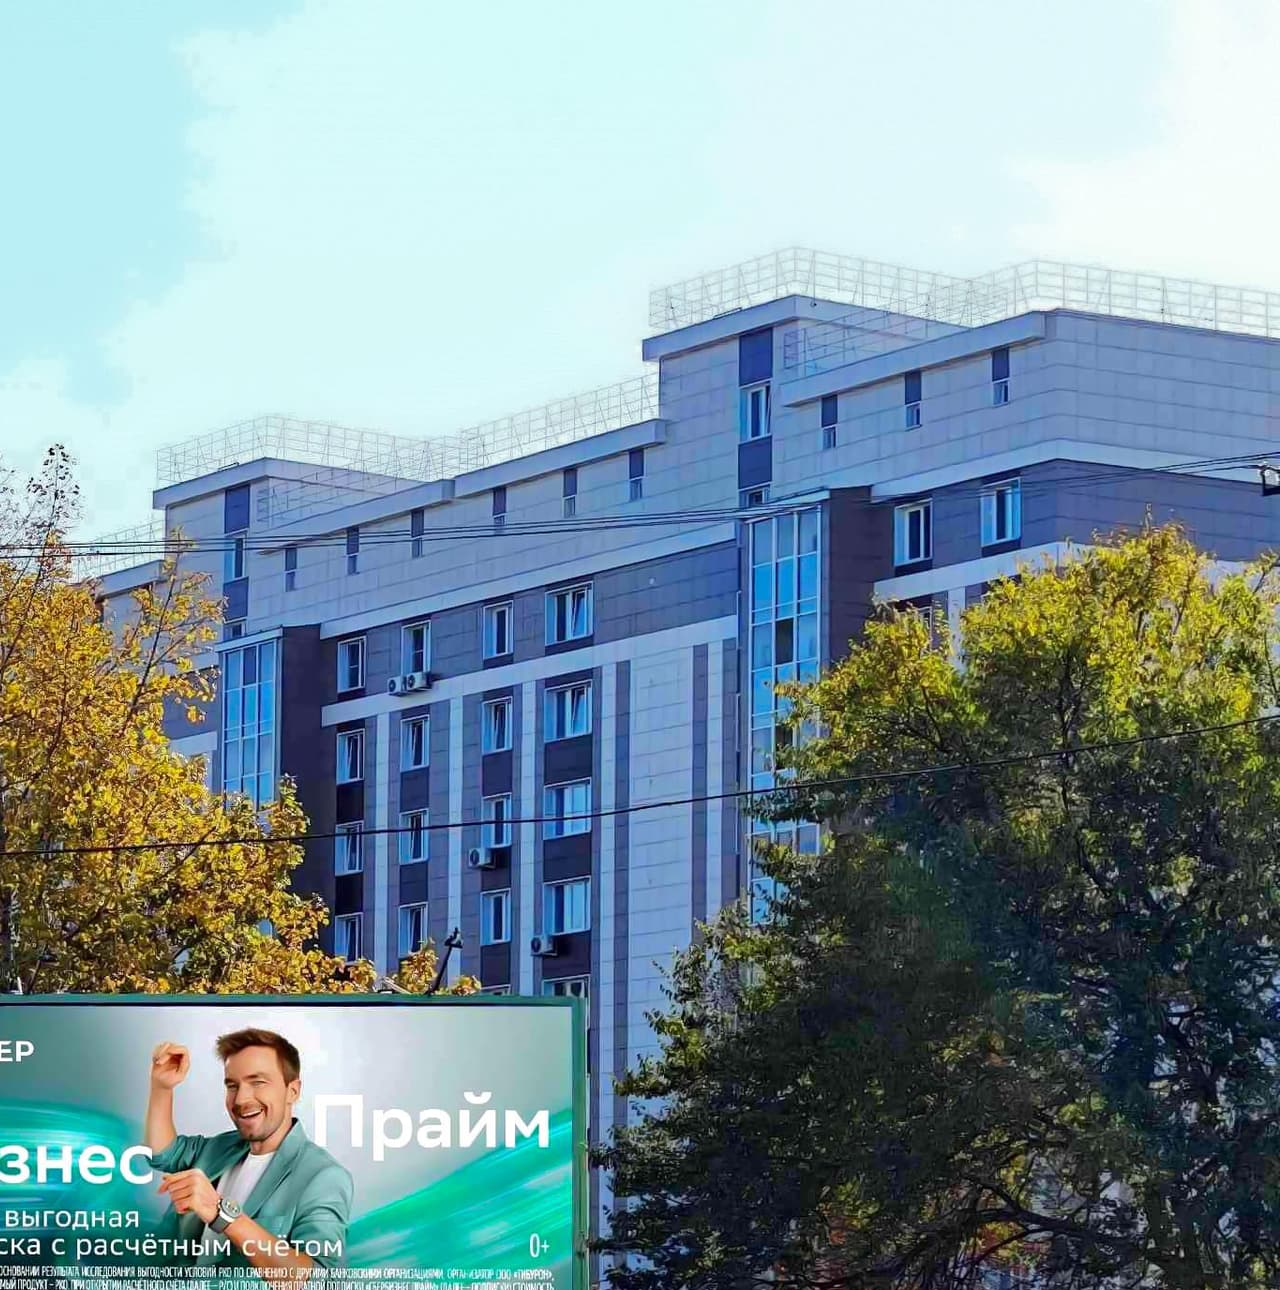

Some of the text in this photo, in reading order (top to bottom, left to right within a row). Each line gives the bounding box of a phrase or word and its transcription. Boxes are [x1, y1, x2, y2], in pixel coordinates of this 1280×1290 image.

[314, 1091, 549, 1161] Прайм
[5, 1208, 139, 1231] выгодная
[51, 1238, 65, 1255] с
[77, 1232, 230, 1260] расчётным
[242, 1234, 342, 1256] счётом
[529, 1232, 550, 1257] 0+
[137, 1267, 183, 1279] ВЫГОДНОСТИ
